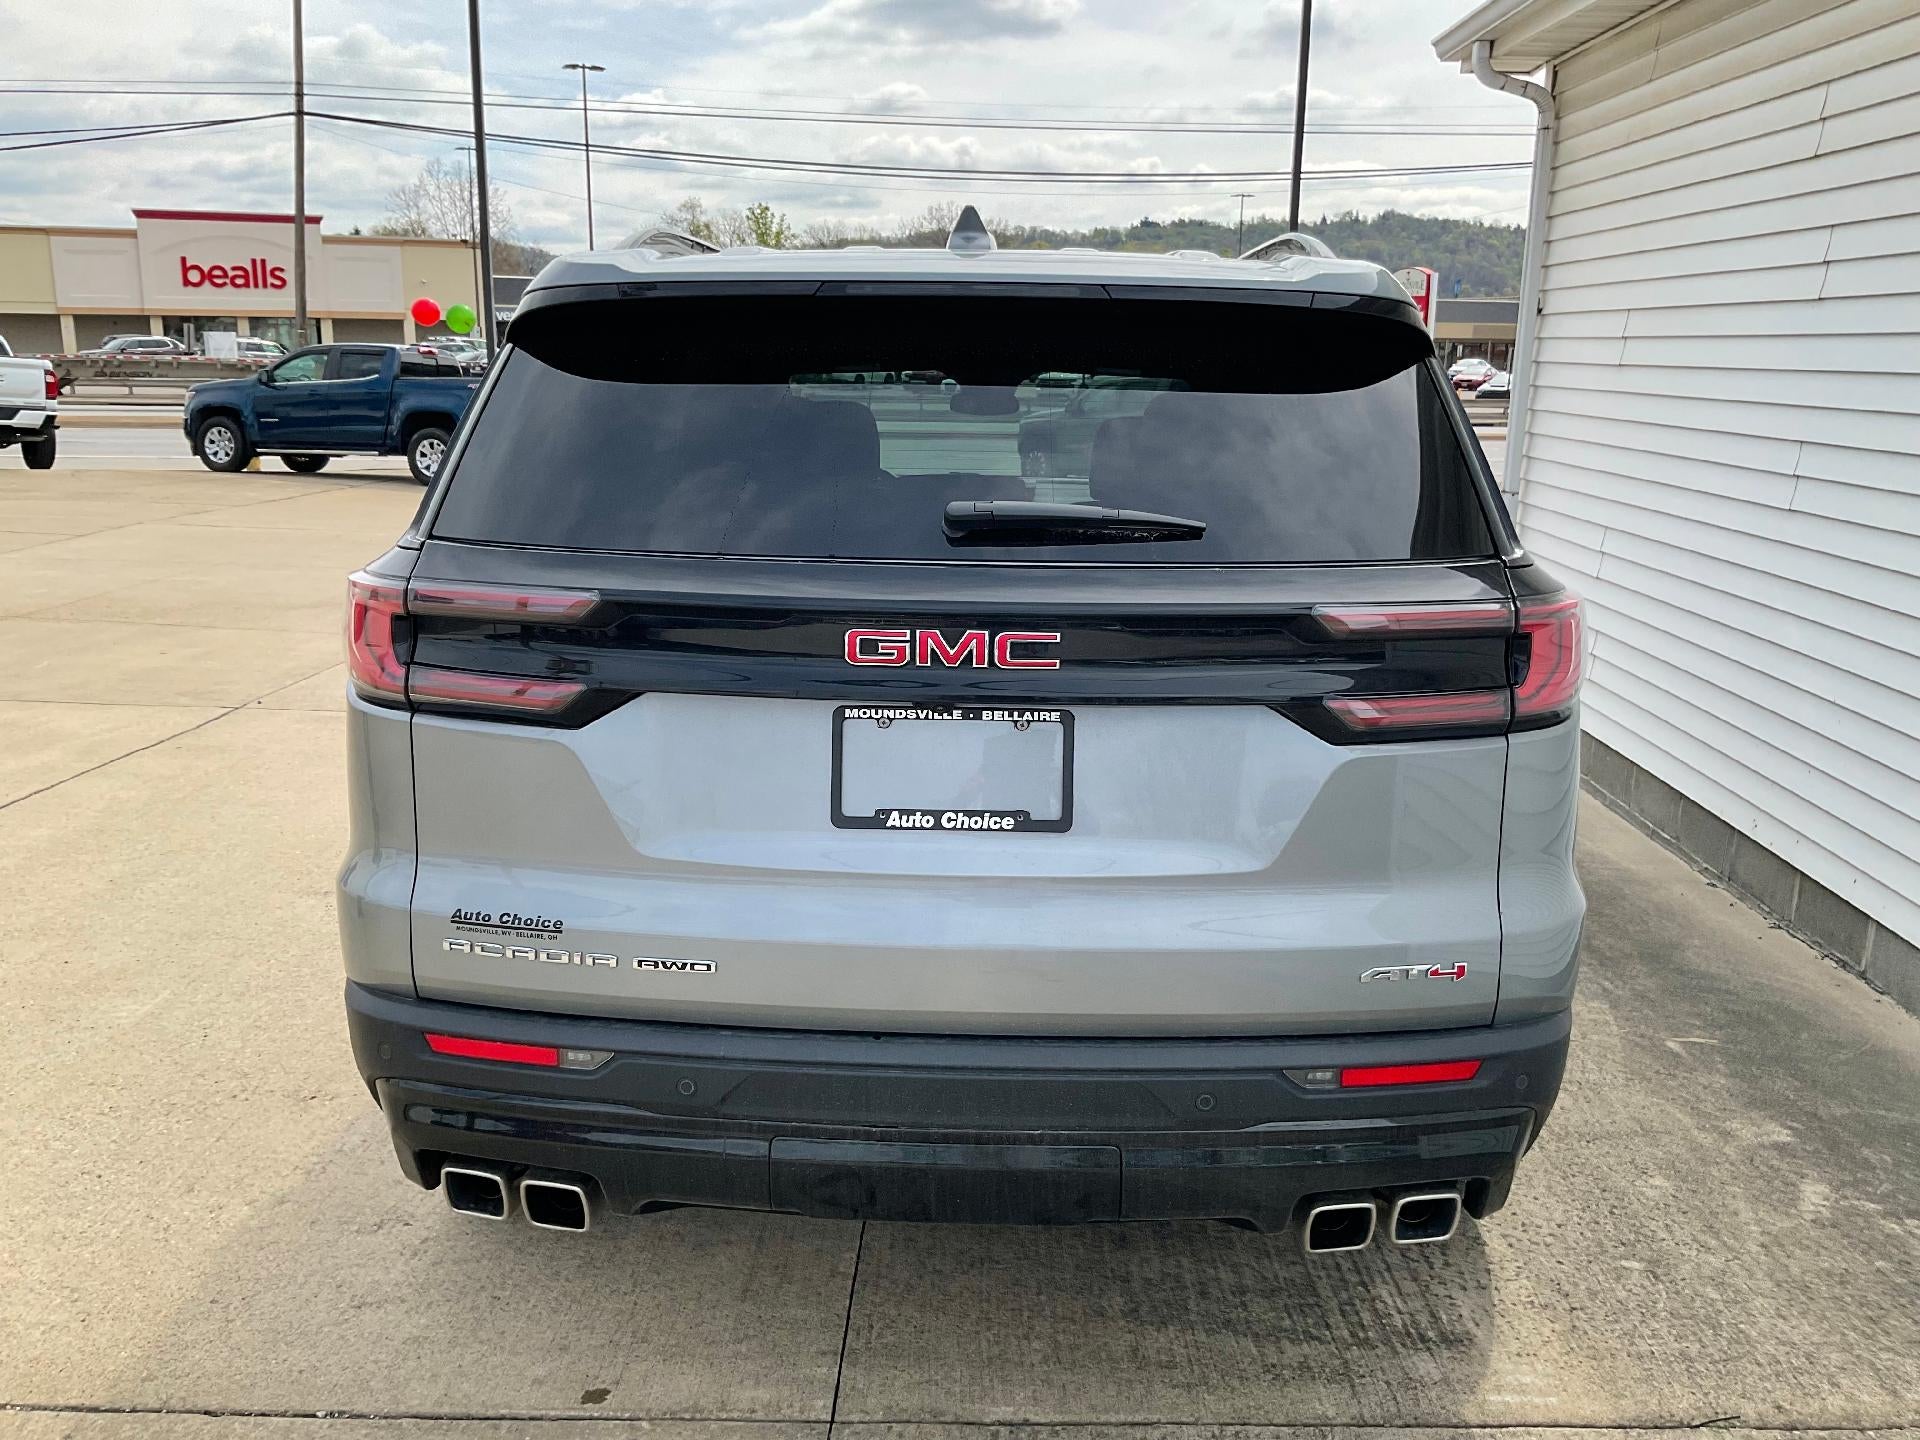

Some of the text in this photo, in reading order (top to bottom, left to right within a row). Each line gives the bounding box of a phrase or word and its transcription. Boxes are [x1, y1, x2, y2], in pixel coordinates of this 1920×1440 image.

[181, 257, 287, 289] bealls
[844, 628, 1061, 669] GMC
[982, 711, 1061, 721] BELLAIRE
[886, 811, 1015, 830] Auto Choice
[450, 908, 564, 930] Auto Choice
[456, 925, 501, 937] MOUNDSVILLE,
[515, 931, 546, 940] BELLAIRE,
[442, 938, 619, 968] ACADIA
[637, 959, 714, 973] AWD
[1360, 962, 1468, 983] AT4
